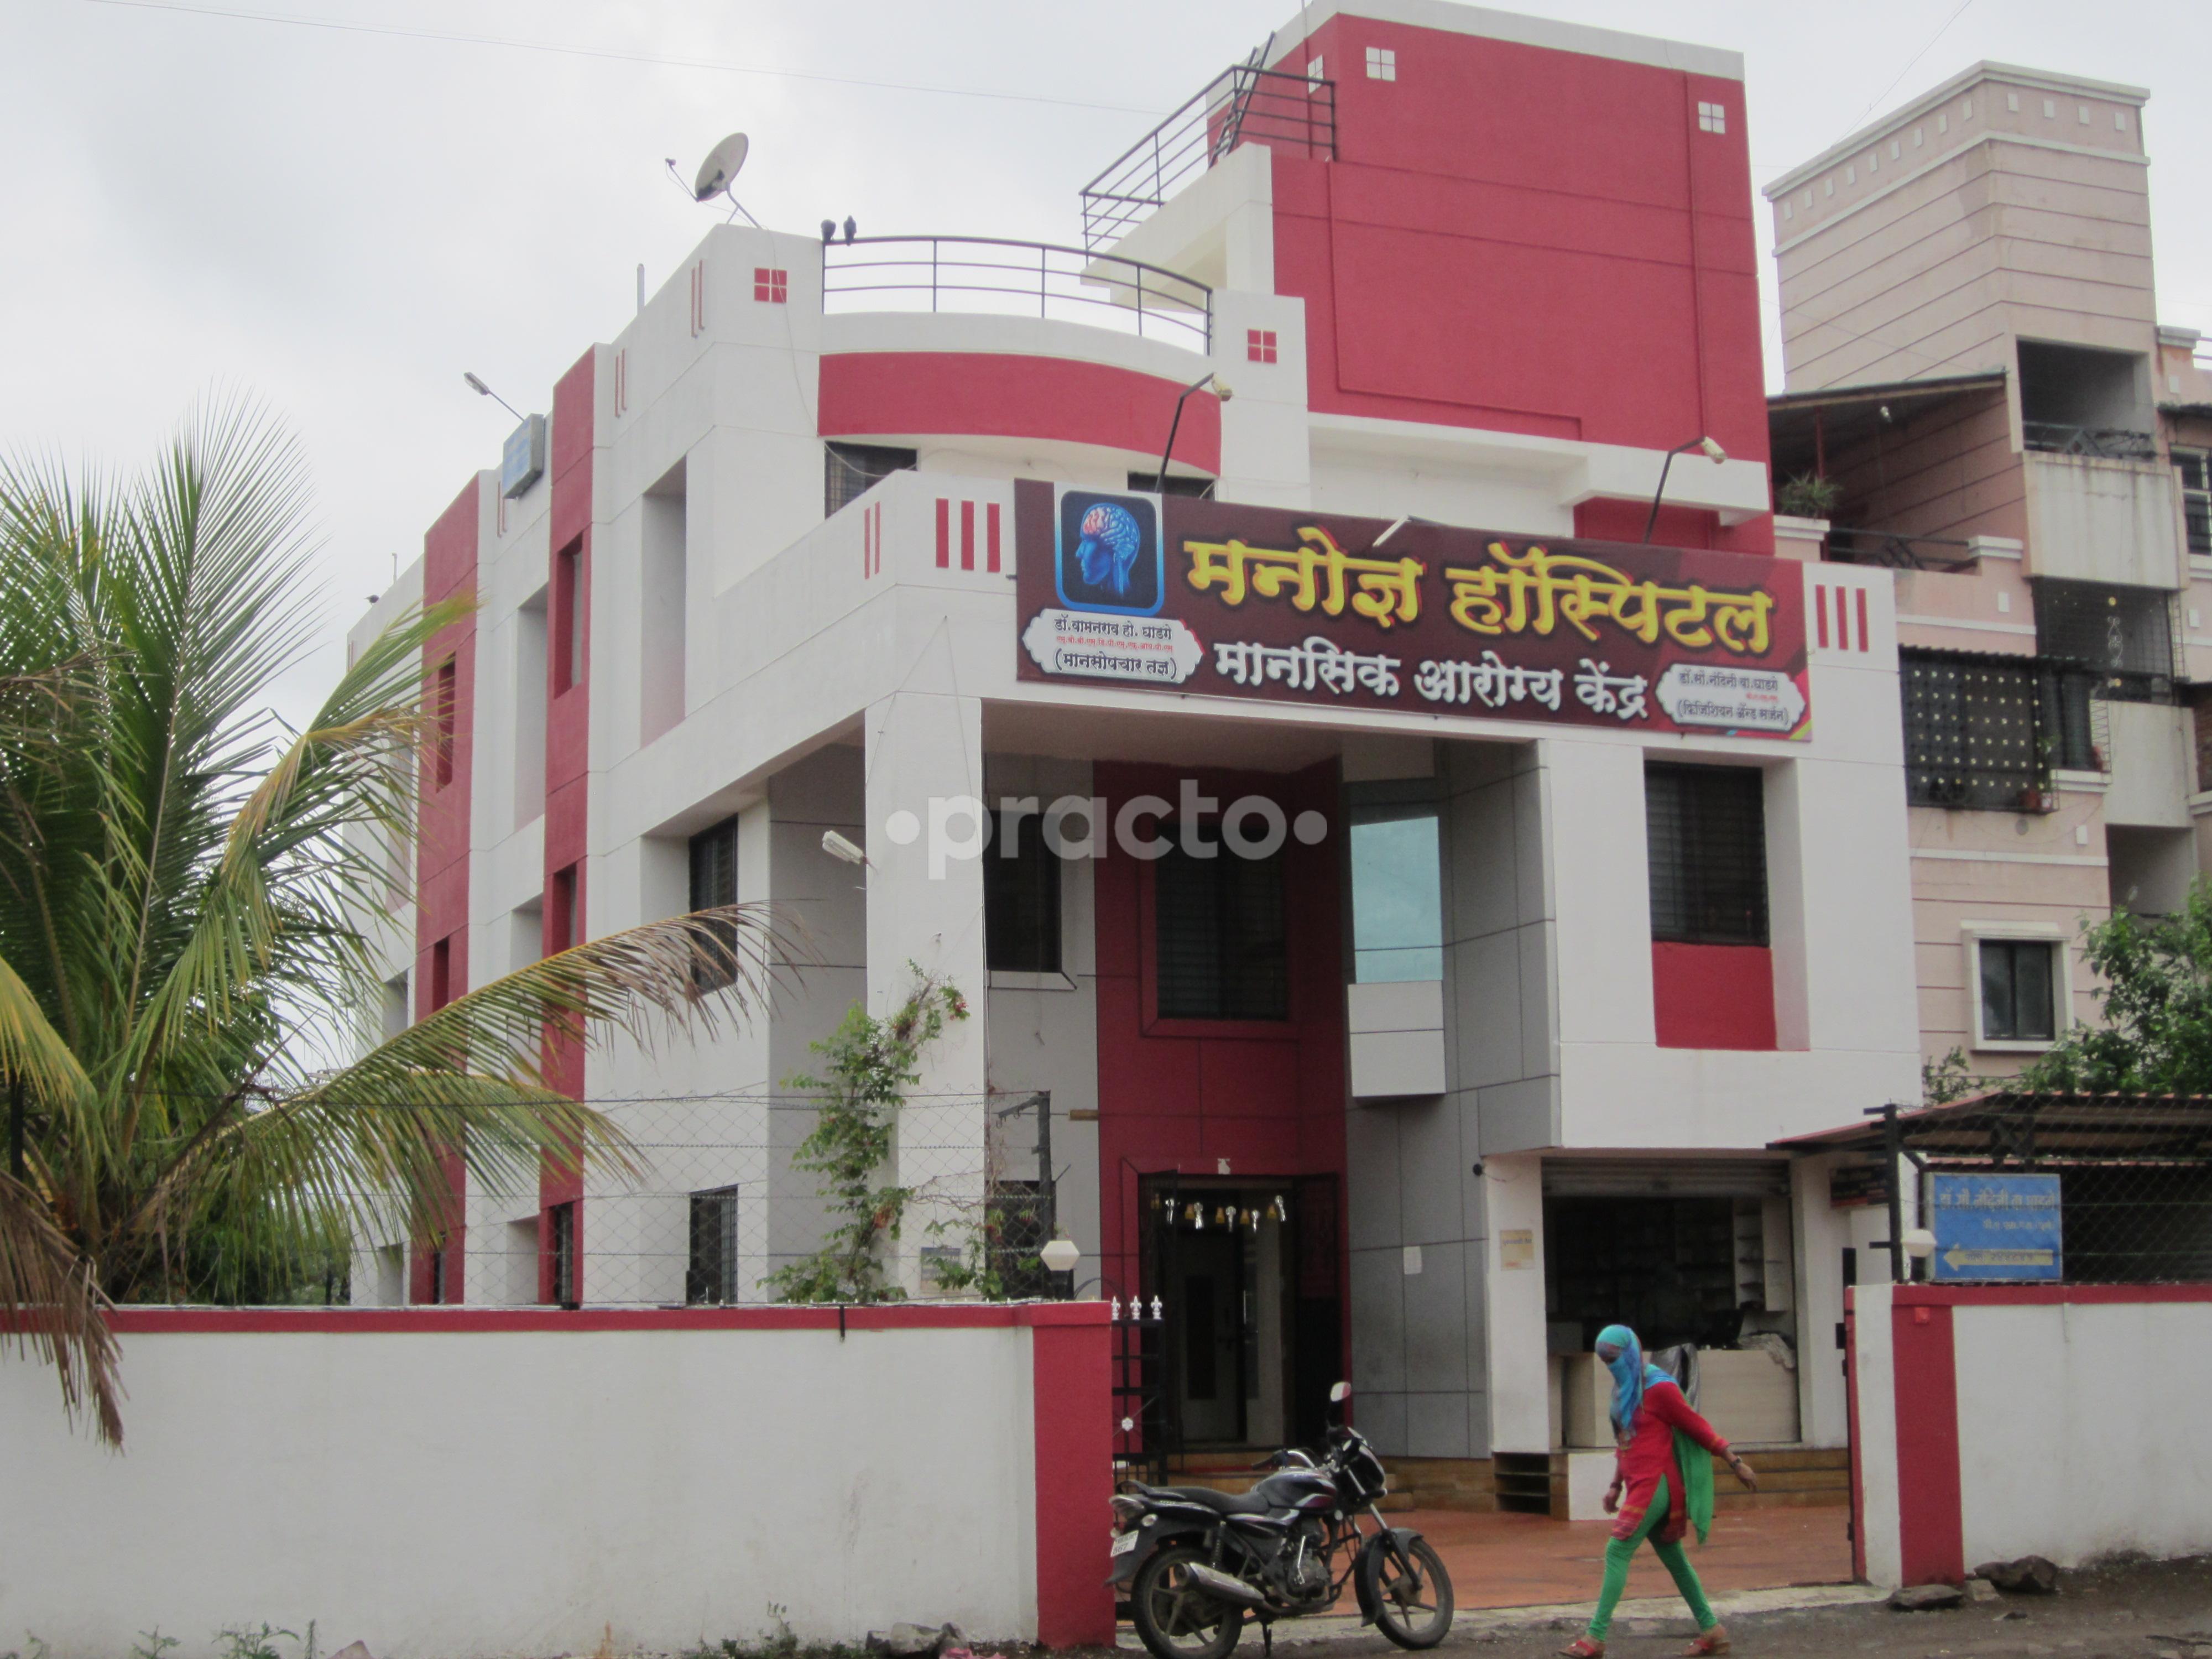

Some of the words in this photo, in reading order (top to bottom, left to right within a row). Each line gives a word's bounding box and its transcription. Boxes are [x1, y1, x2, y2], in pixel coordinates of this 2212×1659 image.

[1183, 526, 1423, 628] मनोज्ञ
[1445, 542, 1773, 654] हॉस्पिटल
[1142, 623, 1172, 640] घाडगे
[1146, 657, 1177, 680] तज्ञ)
[1214, 636, 1401, 696] मानसिक
[1414, 650, 1563, 711] आरोग्य
[1573, 658, 1647, 718] केंद्र
